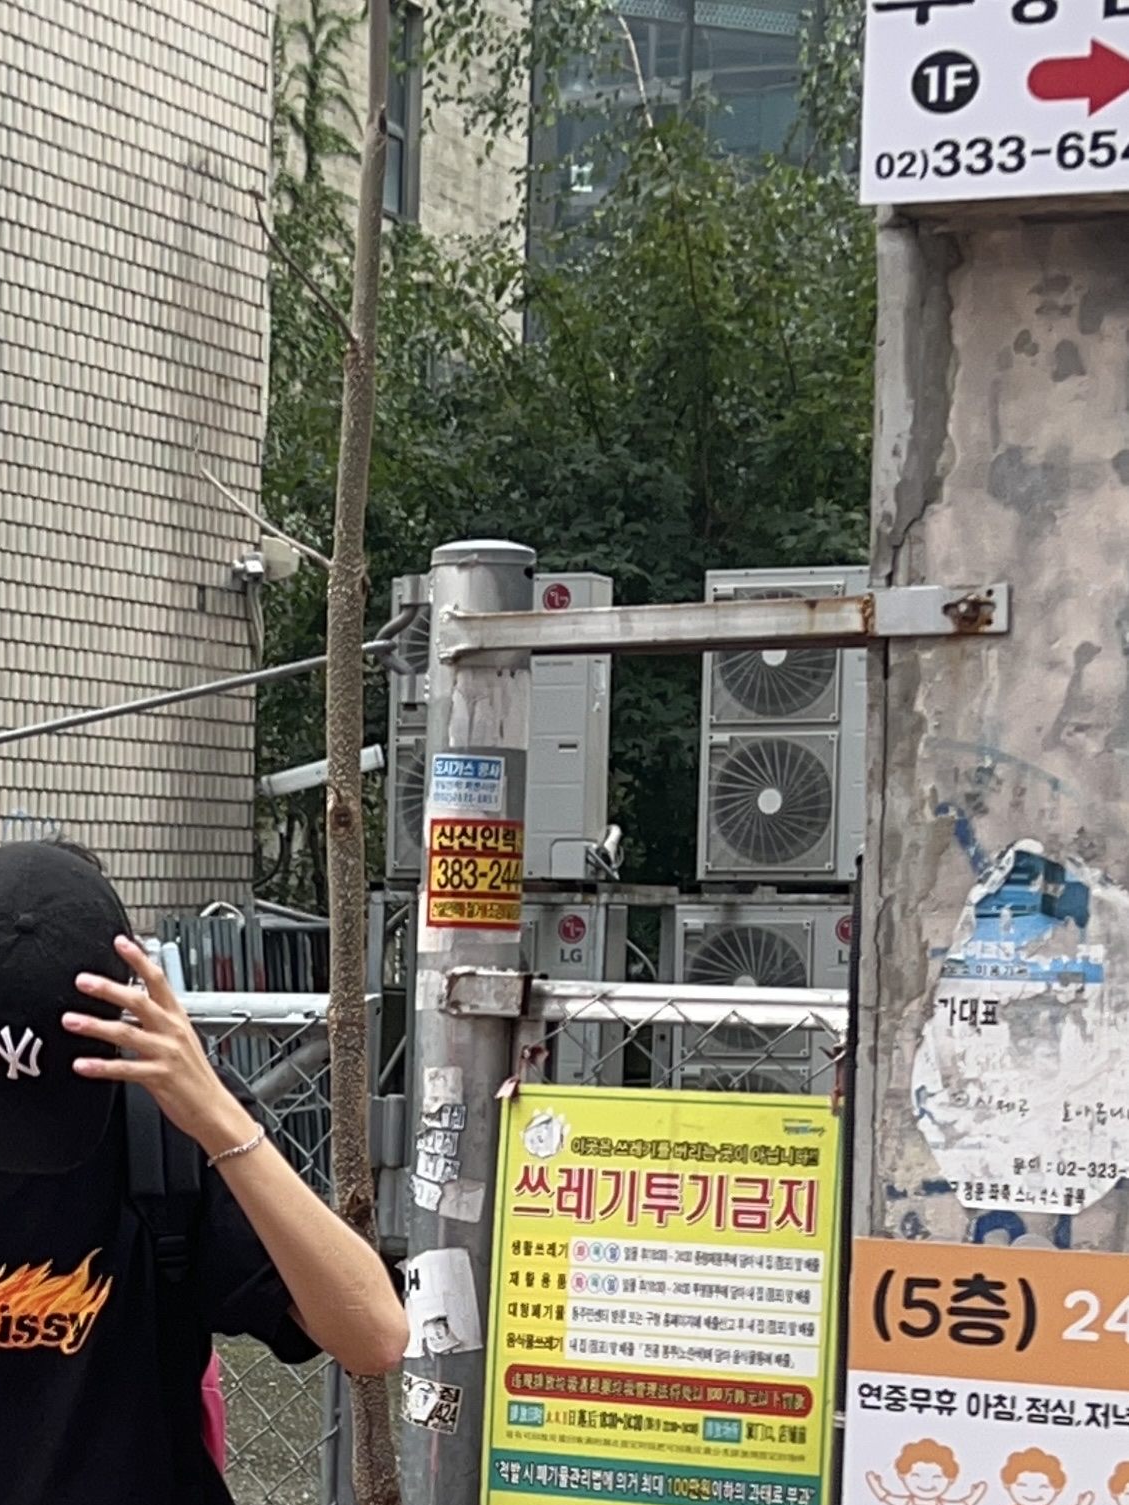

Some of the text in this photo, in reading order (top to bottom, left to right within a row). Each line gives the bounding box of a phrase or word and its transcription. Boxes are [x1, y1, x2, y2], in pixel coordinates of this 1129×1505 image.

[923, 65, 973, 103] 1F
[875, 129, 1129, 180] 02)333-65
[437, 826, 516, 853] 신신인력
[560, 948, 583, 963] LG
[571, 1136, 612, 1156] 이곳은
[614, 1139, 671, 1159] 쓰레기를
[512, 1165, 818, 1236] 쓰레기투기금지
[511, 1240, 569, 1259] 생활쓰레기
[507, 1302, 565, 1321] 대형폐기물
[873, 1269, 1037, 1352] (5층)
[506, 1332, 563, 1352] 음식물쓰레기
[857, 1383, 957, 1416] 연중무휴
